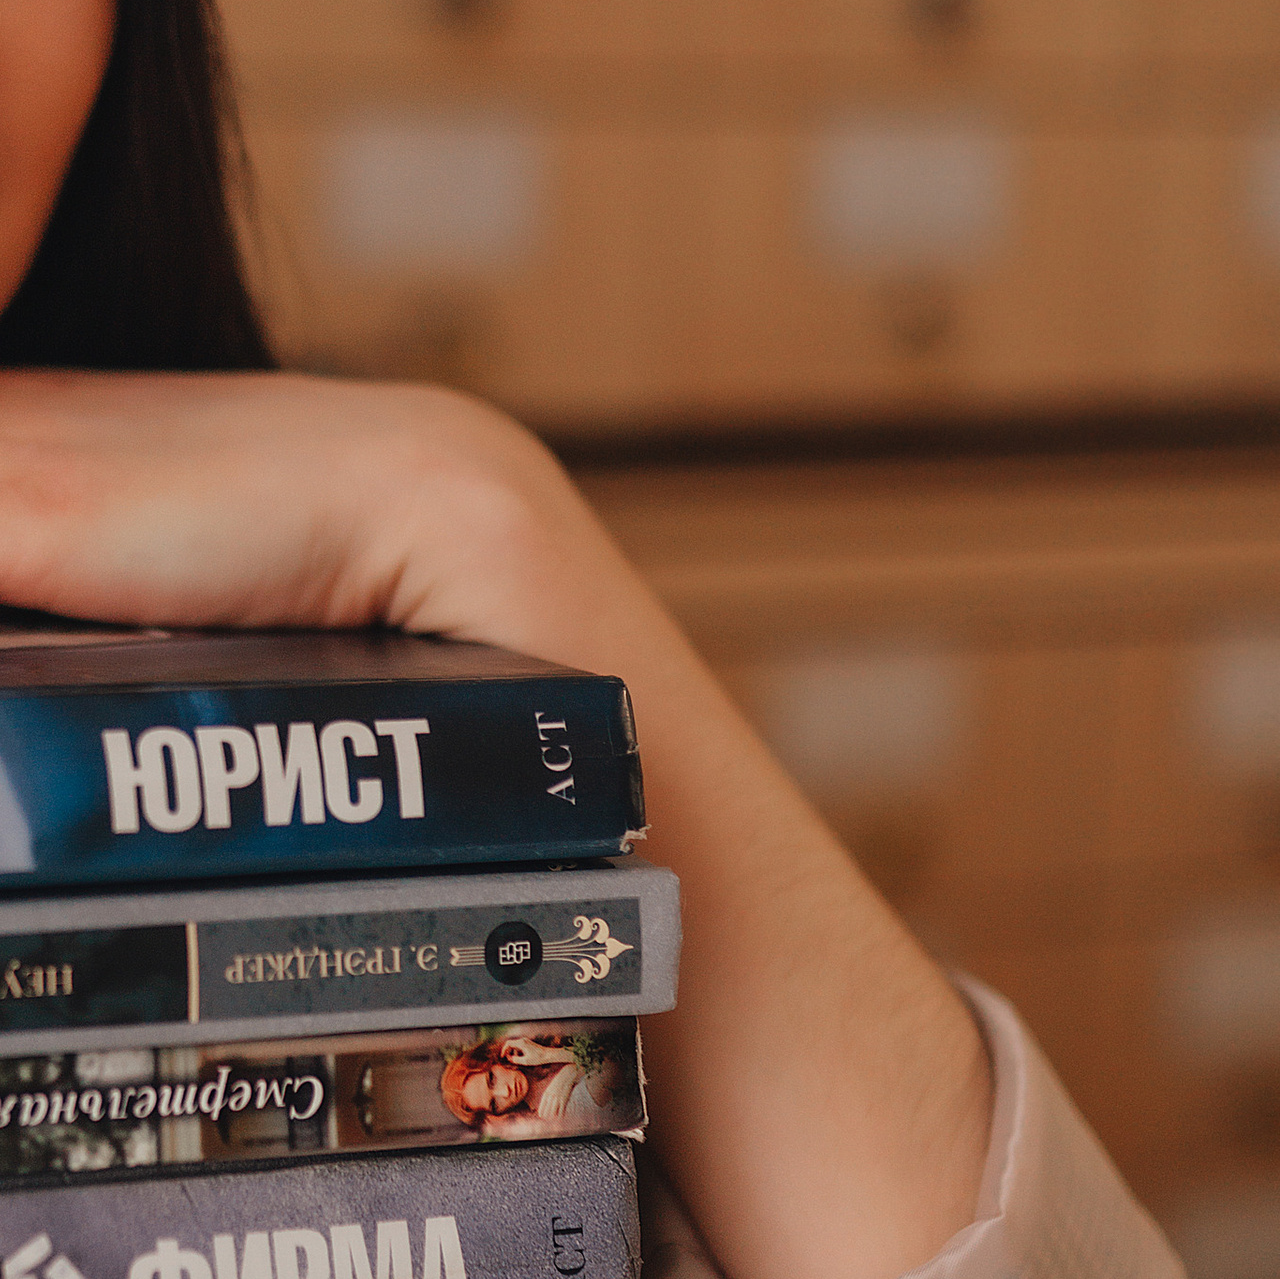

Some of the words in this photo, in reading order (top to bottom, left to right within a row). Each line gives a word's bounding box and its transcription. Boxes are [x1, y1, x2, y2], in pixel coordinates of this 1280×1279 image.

[101, 718, 431, 835] ЮРИСТ
[534, 711, 577, 805] АСТ
[224, 946, 402, 984] ГРЭНДЖЕР
[410, 943, 438, 971] Э.
